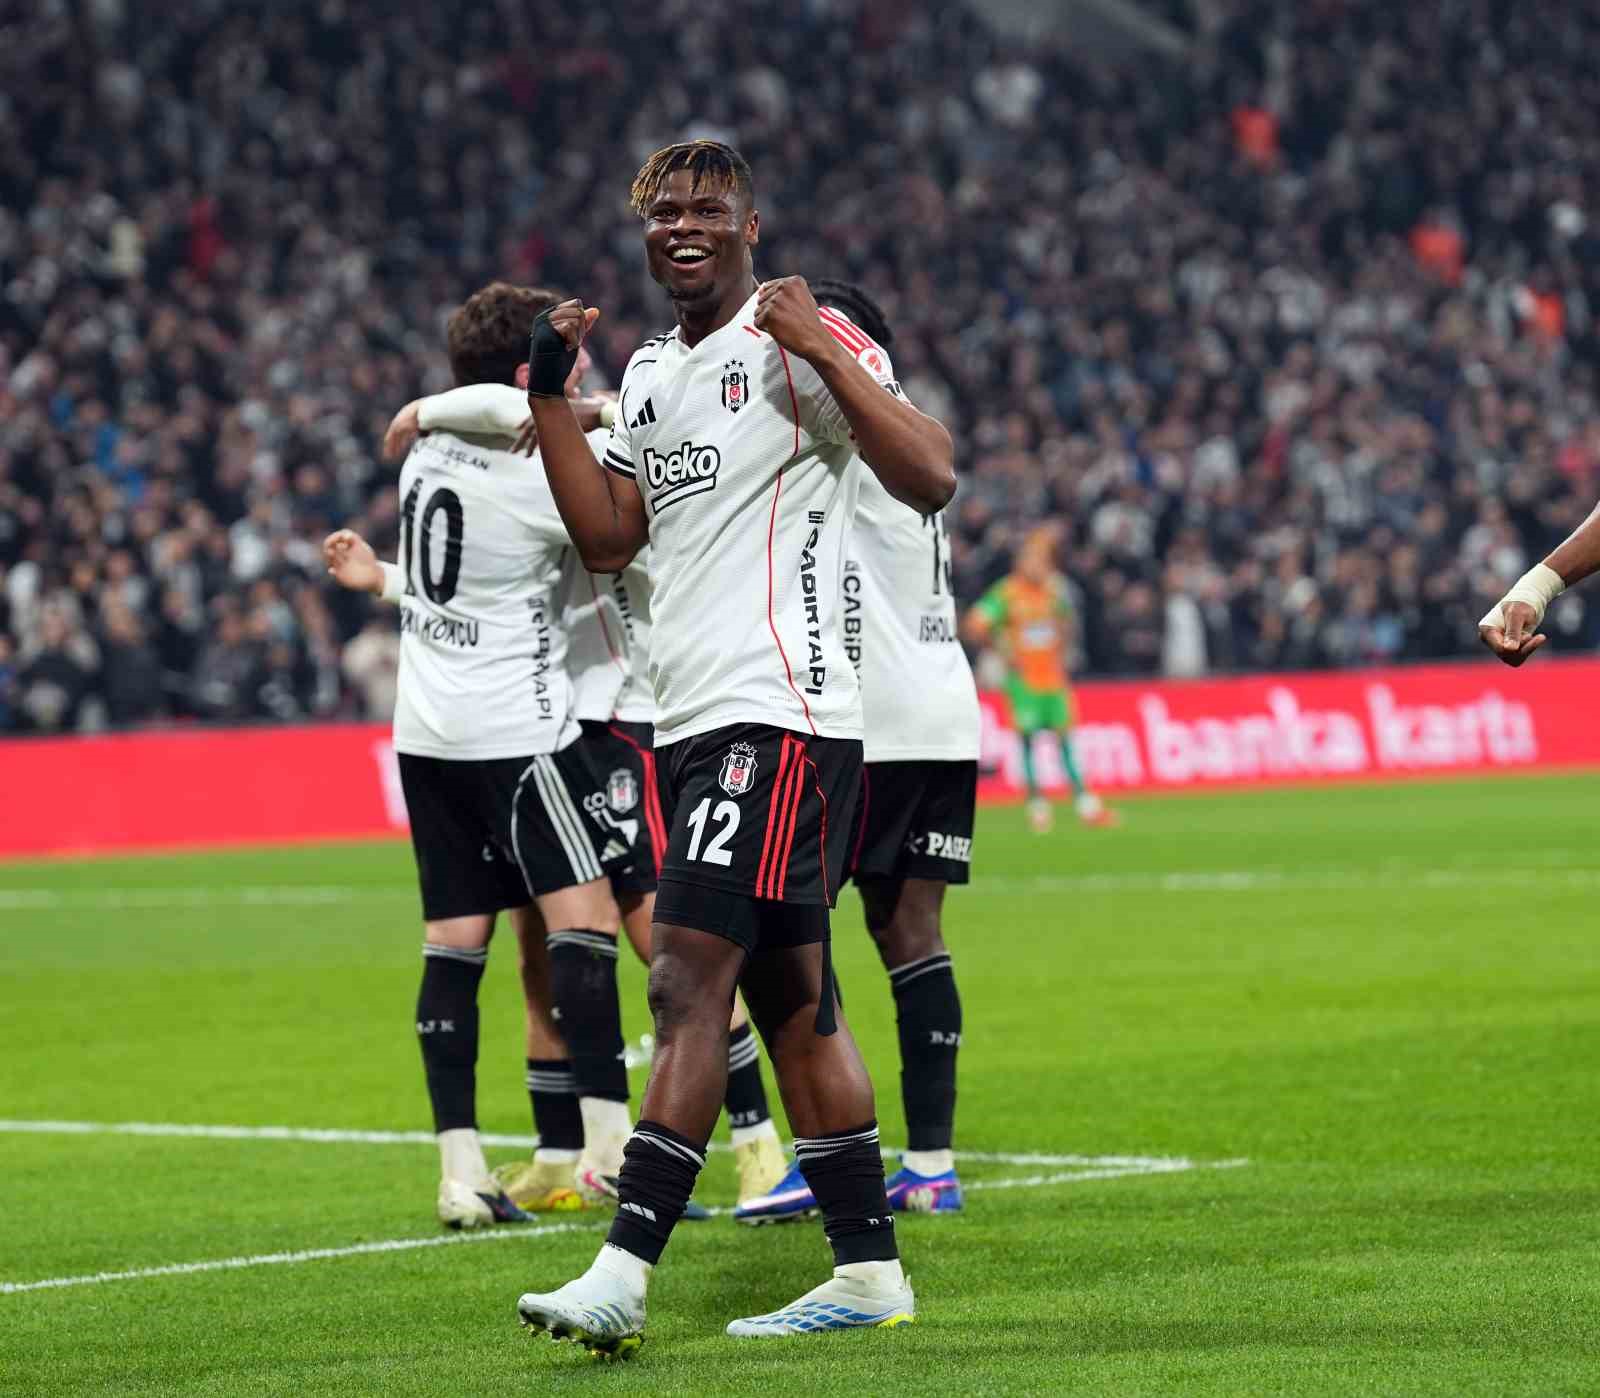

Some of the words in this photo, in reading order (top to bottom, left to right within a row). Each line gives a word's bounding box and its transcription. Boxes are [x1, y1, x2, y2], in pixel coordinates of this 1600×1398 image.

[643, 441, 720, 489] beko
[401, 478, 463, 606] 10
[1138, 685, 1370, 781] banka
[686, 798, 740, 866] 12
